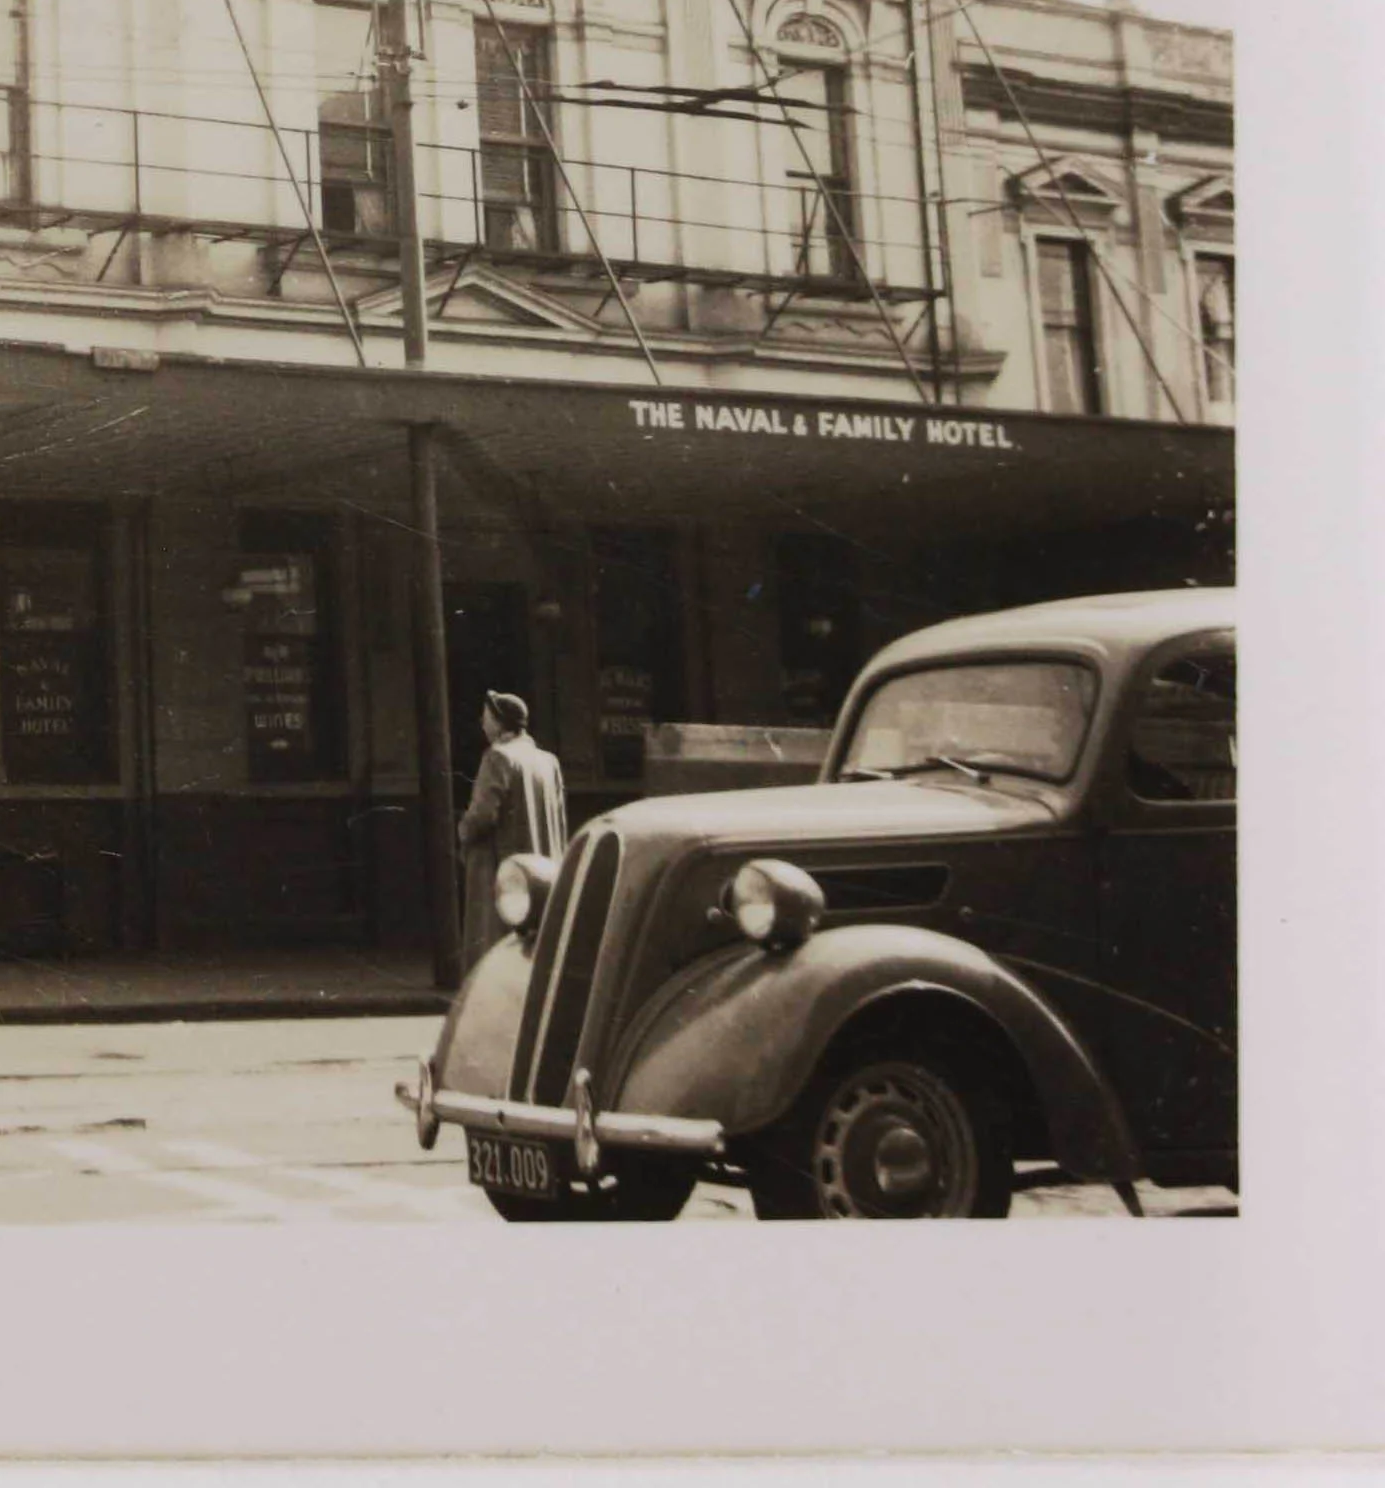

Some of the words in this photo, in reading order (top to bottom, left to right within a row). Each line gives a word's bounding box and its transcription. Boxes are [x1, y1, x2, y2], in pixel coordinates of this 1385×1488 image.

[628, 399, 685, 429] THE
[695, 404, 788, 436] NAVAL
[793, 413, 808, 437] &
[818, 412, 914, 442] FAMILY
[927, 419, 1013, 449] HOTEL
